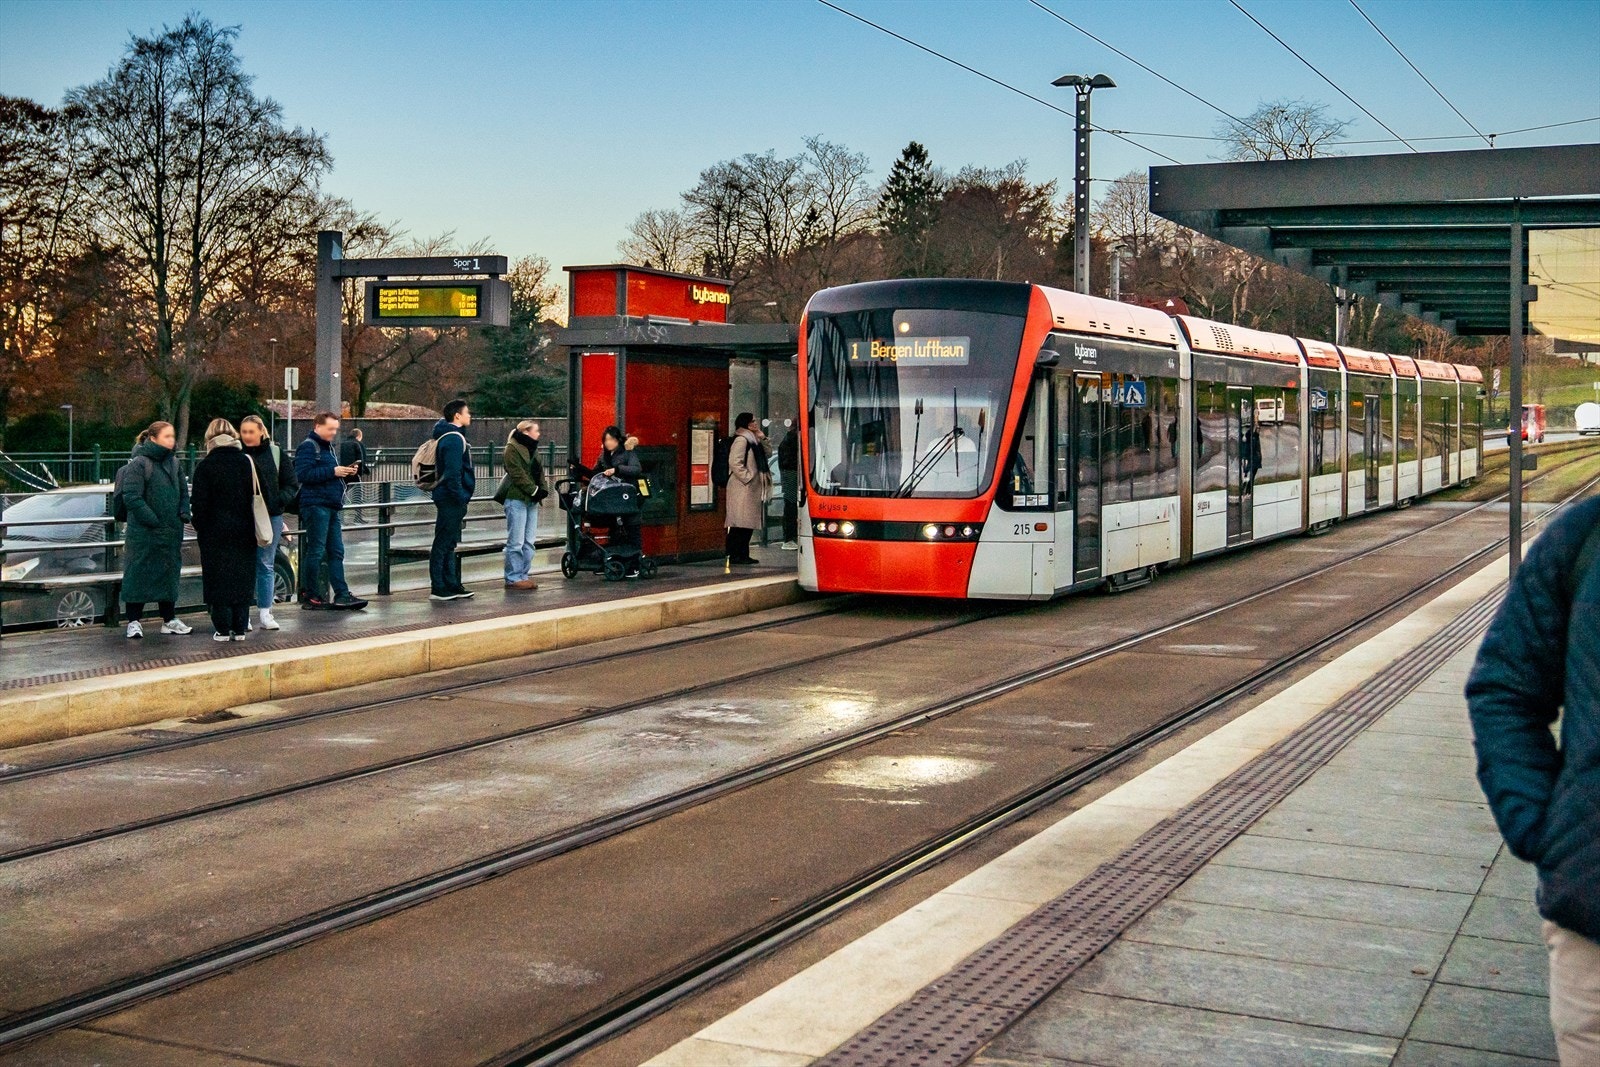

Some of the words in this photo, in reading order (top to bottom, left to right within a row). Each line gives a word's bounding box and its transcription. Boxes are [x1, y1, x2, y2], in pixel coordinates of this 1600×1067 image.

[453, 258, 471, 268] Spor
[473, 258, 480, 270] 1
[693, 285, 730, 304] bybanen
[851, 342, 858, 360] 1
[870, 341, 912, 361] Bergen
[914, 341, 964, 358] lufthavn
[1074, 342, 1097, 360] bybanen
[818, 502, 841, 513] skyss
[1014, 524, 1030, 535] 215
